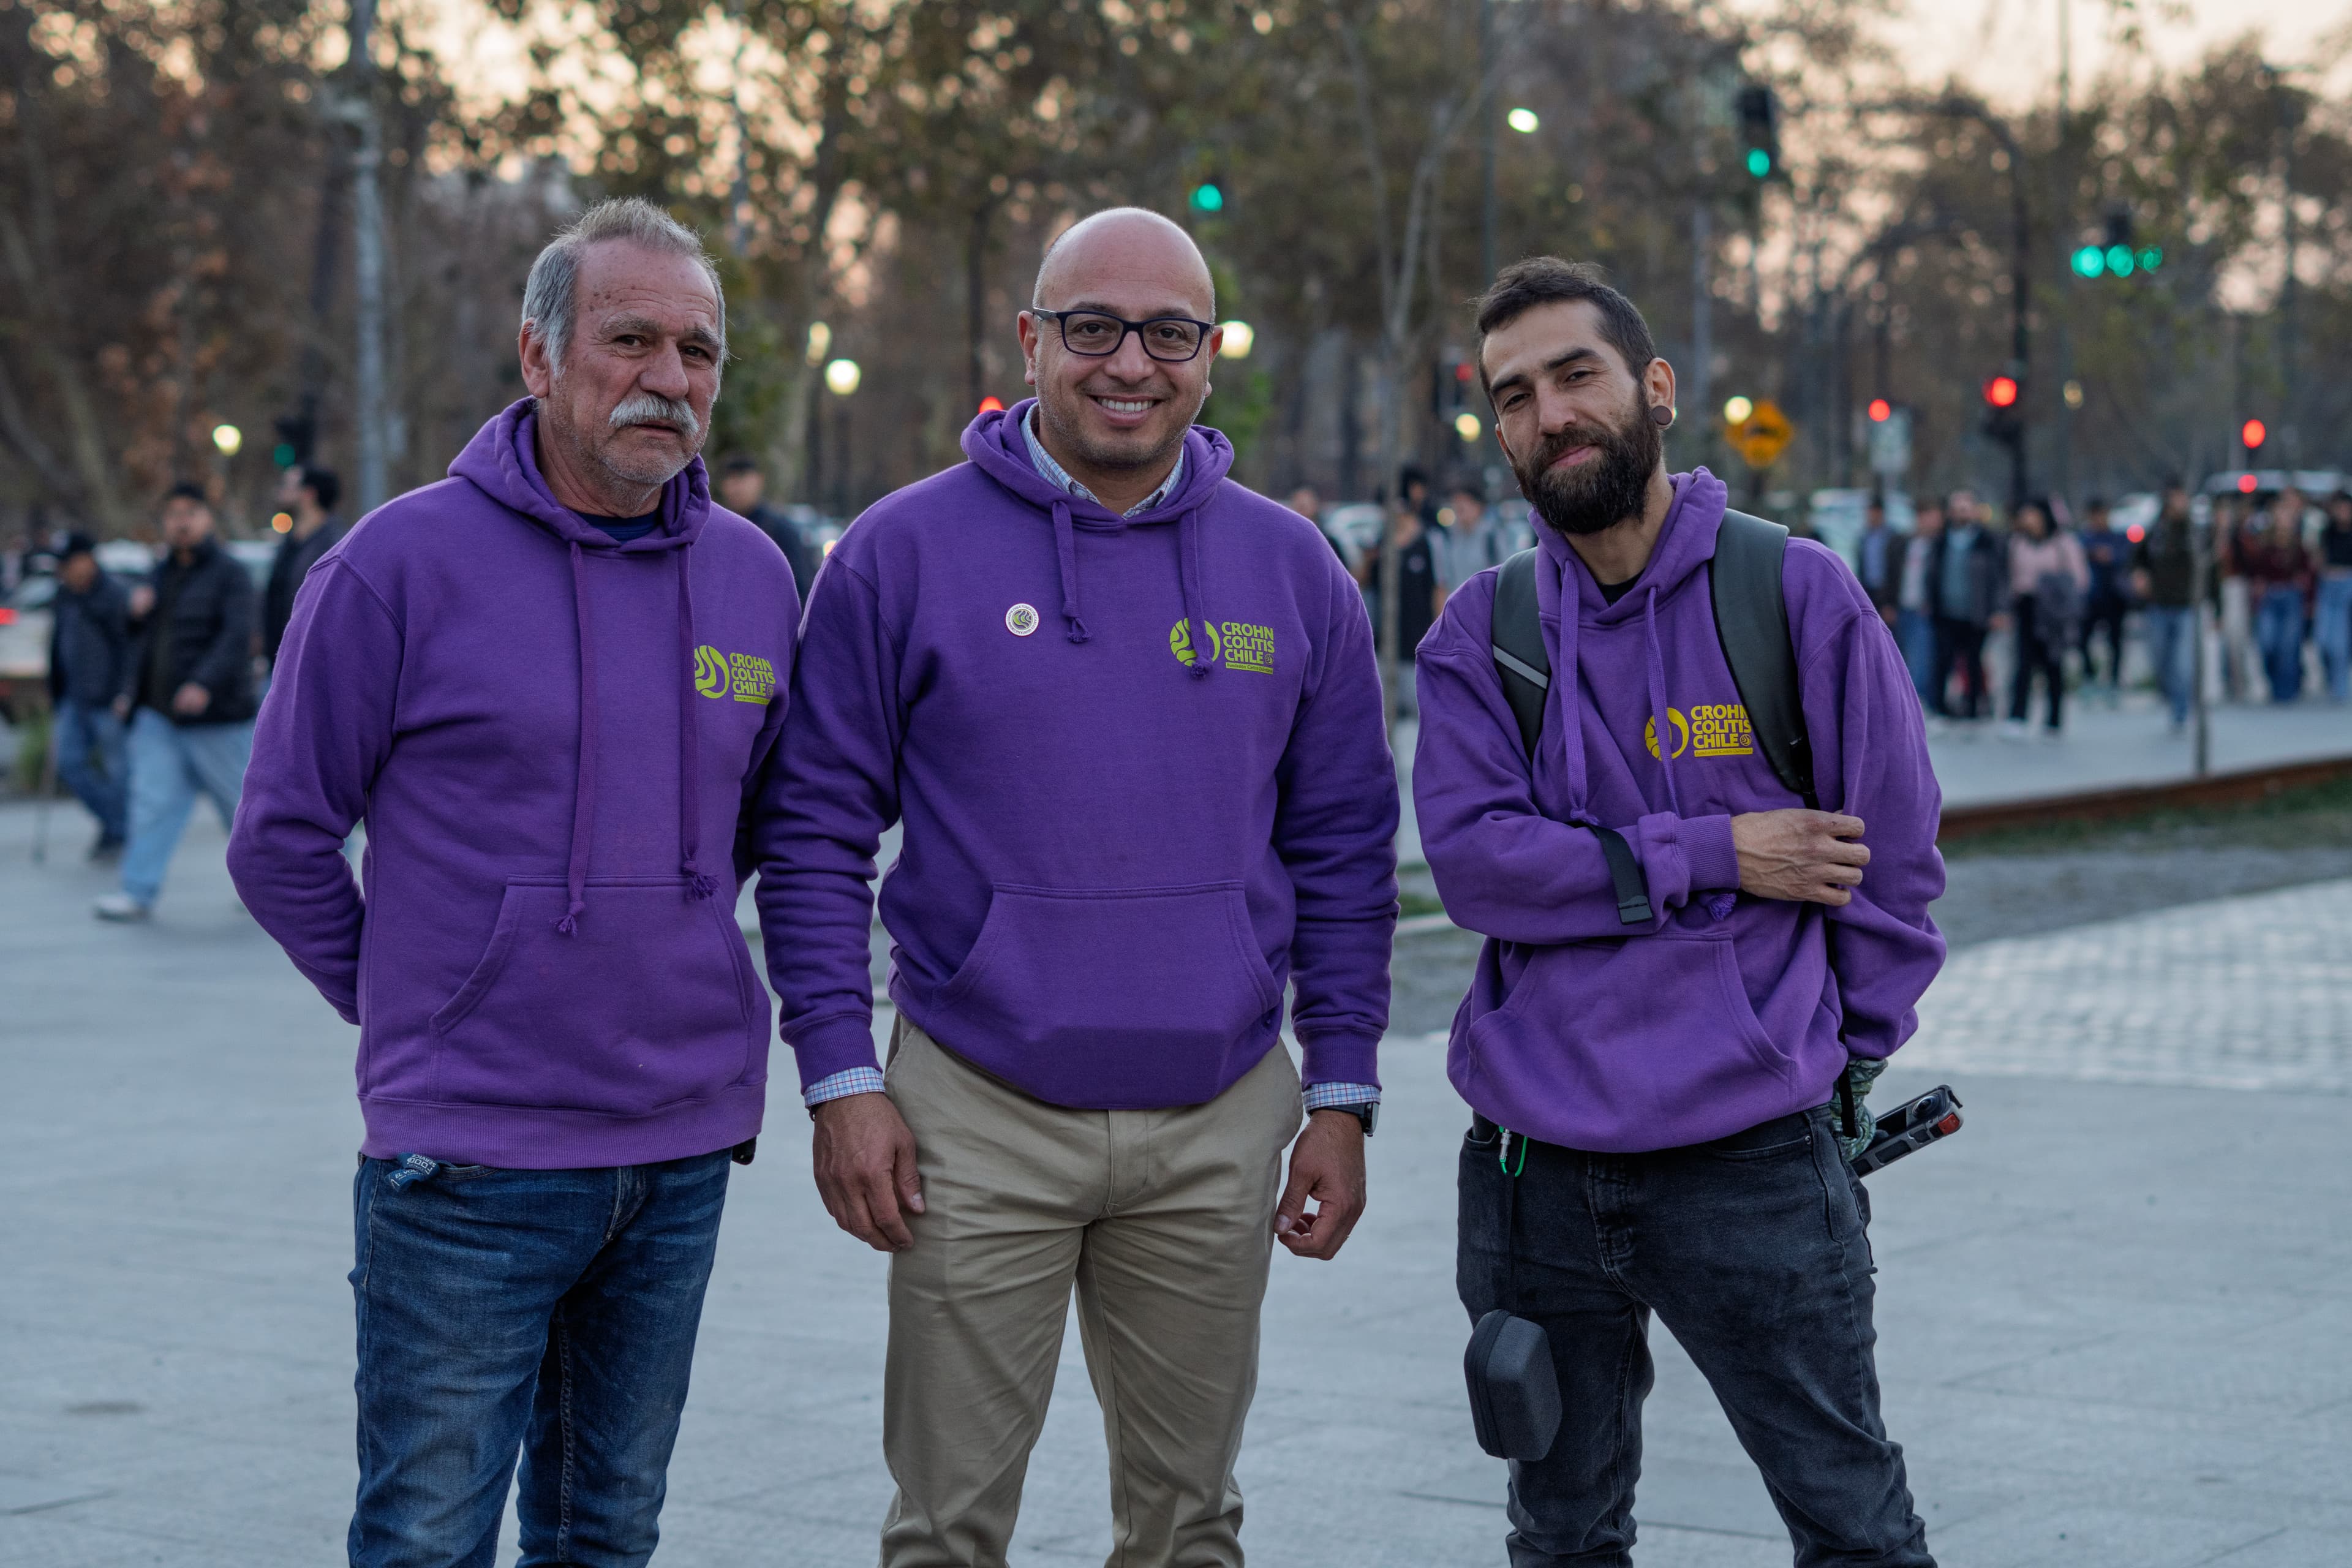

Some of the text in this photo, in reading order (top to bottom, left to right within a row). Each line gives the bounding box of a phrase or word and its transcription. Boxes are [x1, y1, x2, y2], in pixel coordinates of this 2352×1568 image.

[1221, 622, 1274, 641] CROHN
[1223, 636, 1275, 653] COLITIS
[729, 652, 772, 671] CROHN
[1225, 649, 1264, 665] CHILE
[731, 667, 775, 684] COLITIS
[733, 680, 766, 696] CHILE
[1692, 720, 1752, 734] COLITIS
[1694, 733, 1739, 748] CHILE
